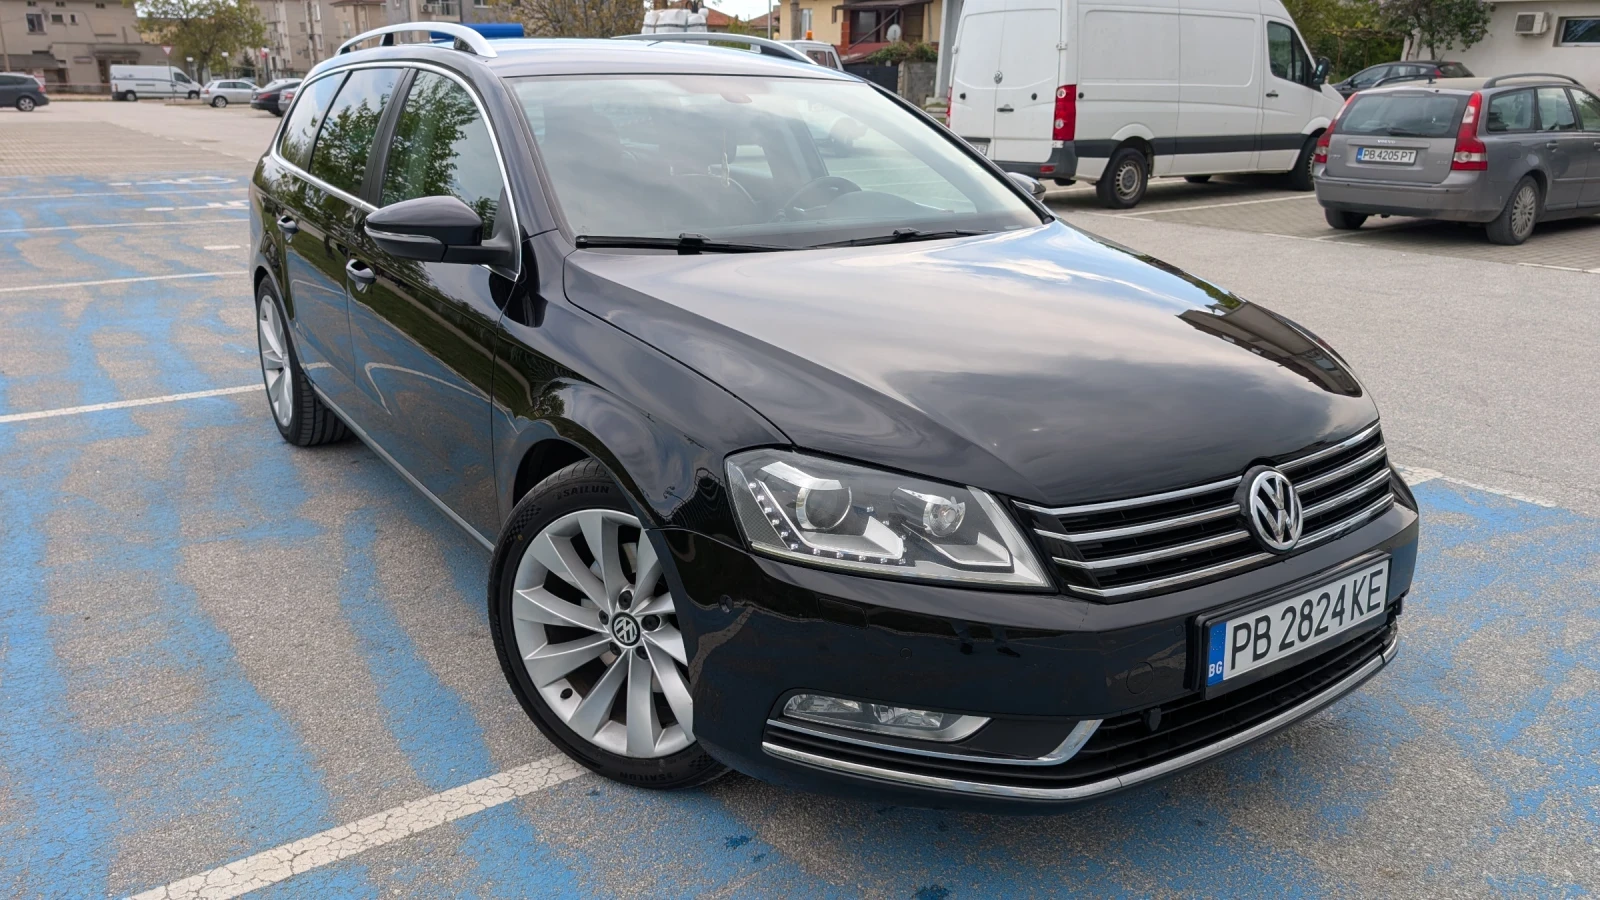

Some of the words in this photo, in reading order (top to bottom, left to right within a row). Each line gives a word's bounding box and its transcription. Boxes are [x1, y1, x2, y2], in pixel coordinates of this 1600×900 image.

[1363, 149, 1376, 160] PB
[1377, 150, 1400, 161] 4205
[1400, 151, 1415, 162] PT
[563, 485, 610, 497] SAILUN
[1230, 615, 1272, 670] PB
[1278, 584, 1347, 652] 2824
[1350, 568, 1384, 621] KE
[1208, 661, 1223, 678] BG
